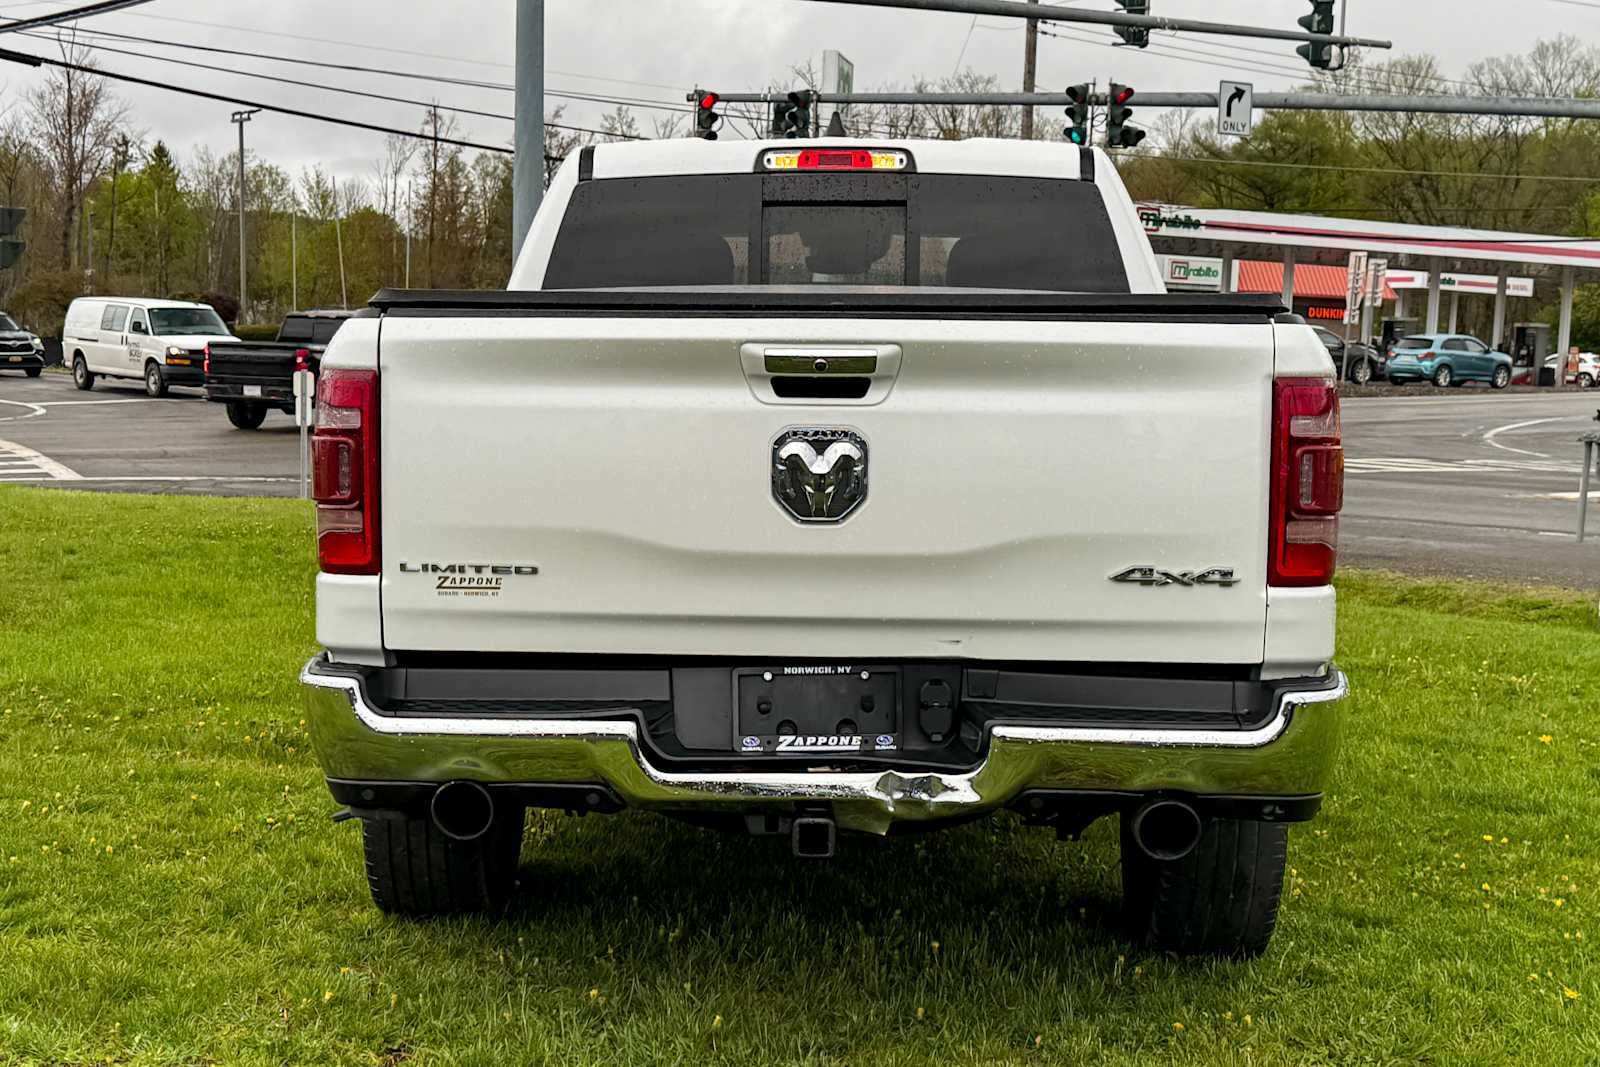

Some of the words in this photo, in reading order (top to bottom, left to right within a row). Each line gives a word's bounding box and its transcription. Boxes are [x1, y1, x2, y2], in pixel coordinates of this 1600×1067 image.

[1223, 120, 1247, 132] ONLY
[1173, 265, 1219, 278] Mirabito
[399, 562, 539, 575] LIMITED
[436, 575, 503, 590] ZAPPONE
[784, 666, 835, 675] NORWICH,
[837, 666, 852, 674] NY
[776, 735, 863, 751] ZAPPONE
